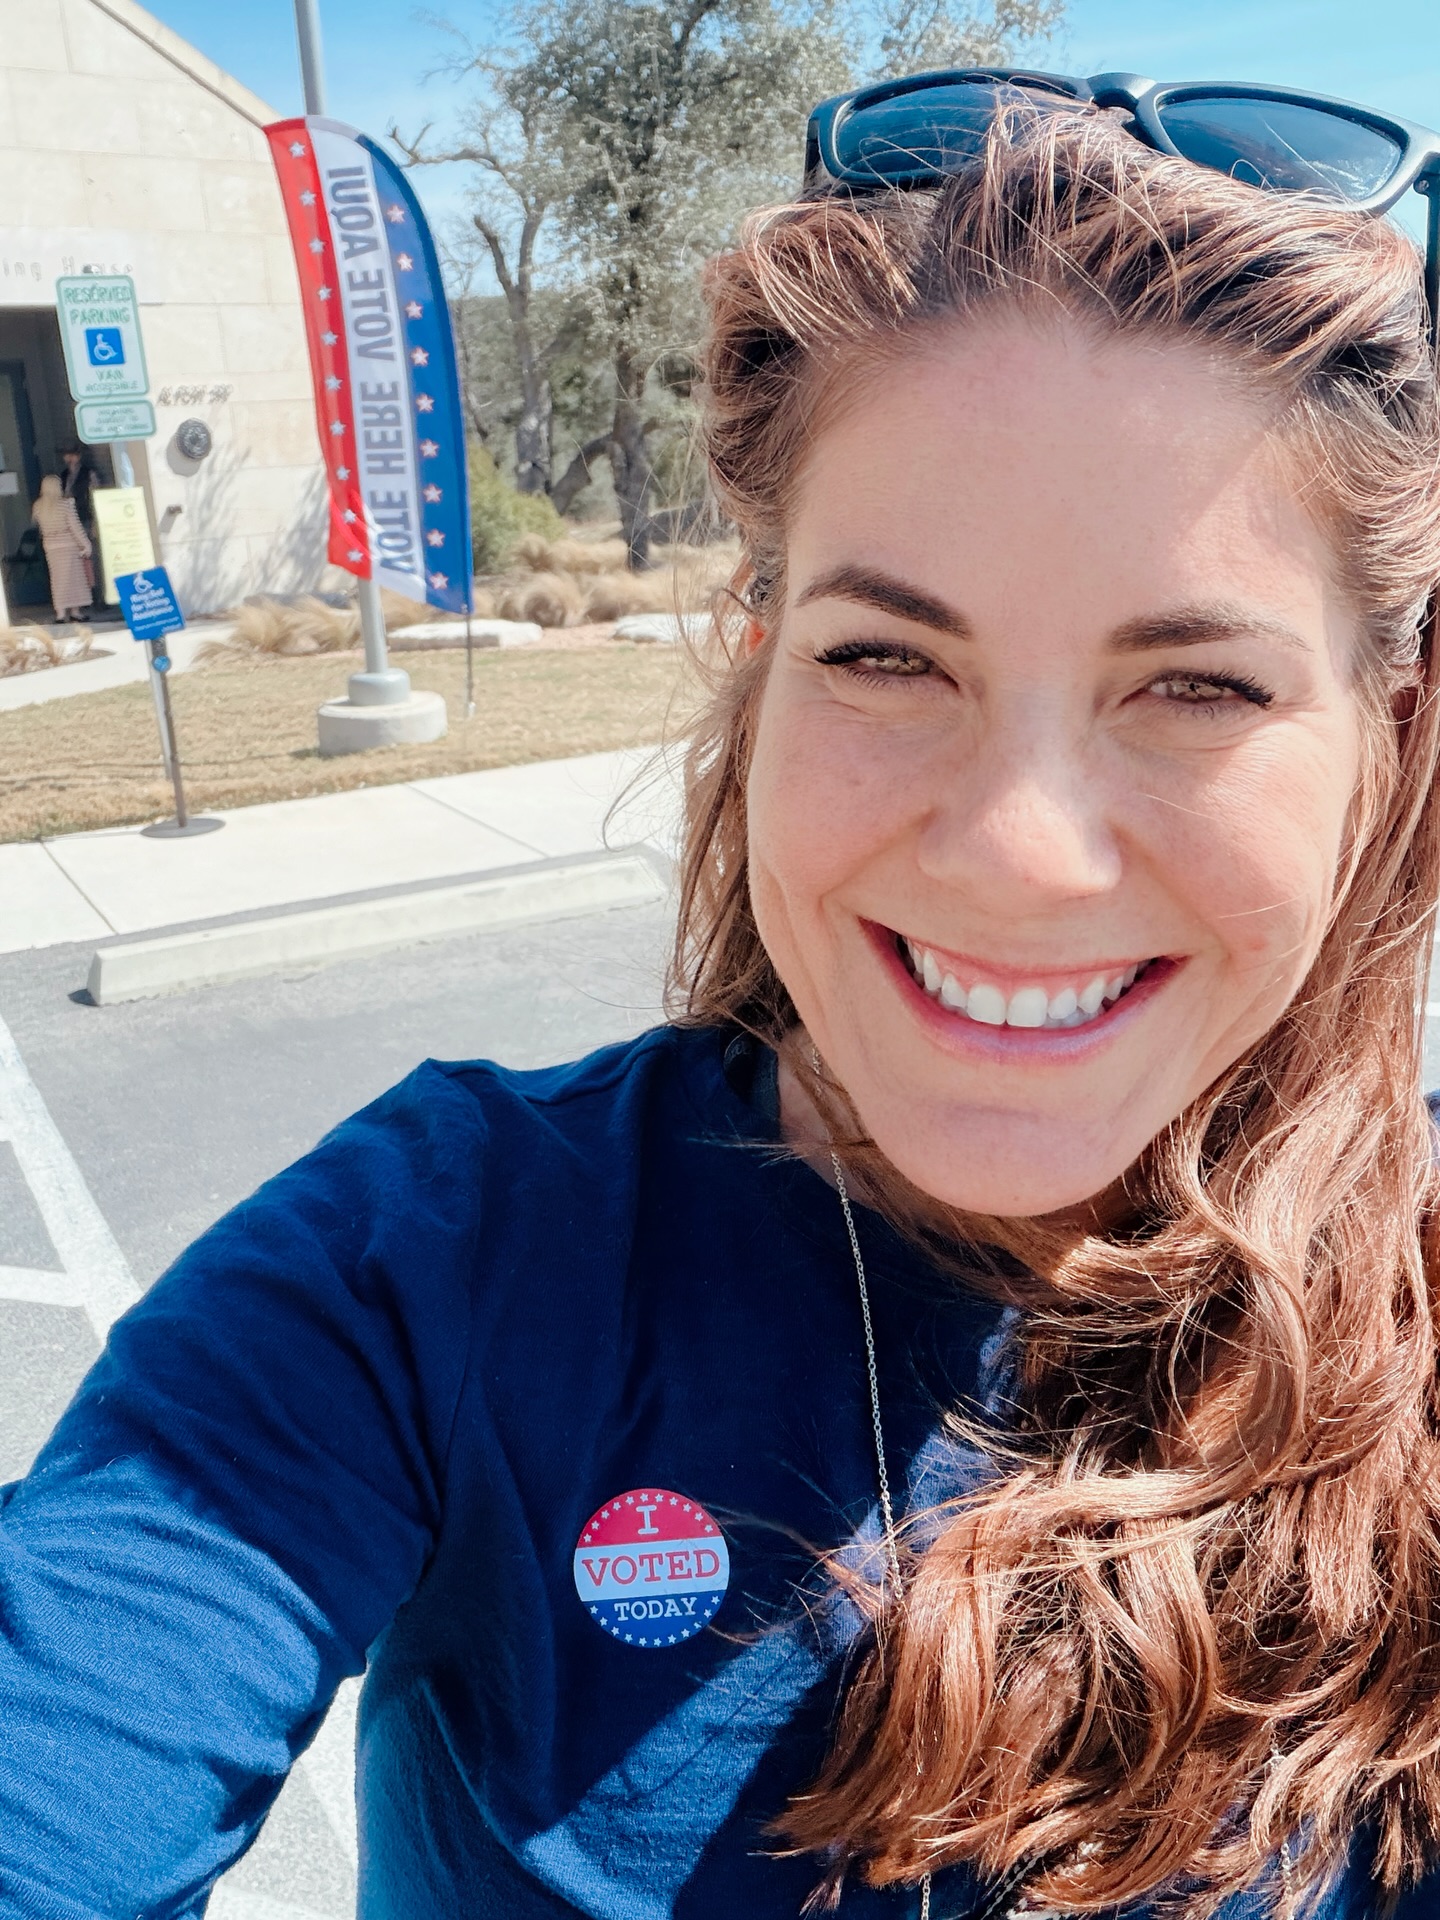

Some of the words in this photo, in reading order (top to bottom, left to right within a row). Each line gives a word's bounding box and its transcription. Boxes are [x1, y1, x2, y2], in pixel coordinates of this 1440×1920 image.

[64, 285, 132, 304] RESERVED
[70, 306, 131, 325] PARKING
[95, 368, 125, 381] VAN
[636, 1504, 659, 1535] I
[581, 1549, 720, 1586] VOTED
[614, 1597, 697, 1621] TODAY
